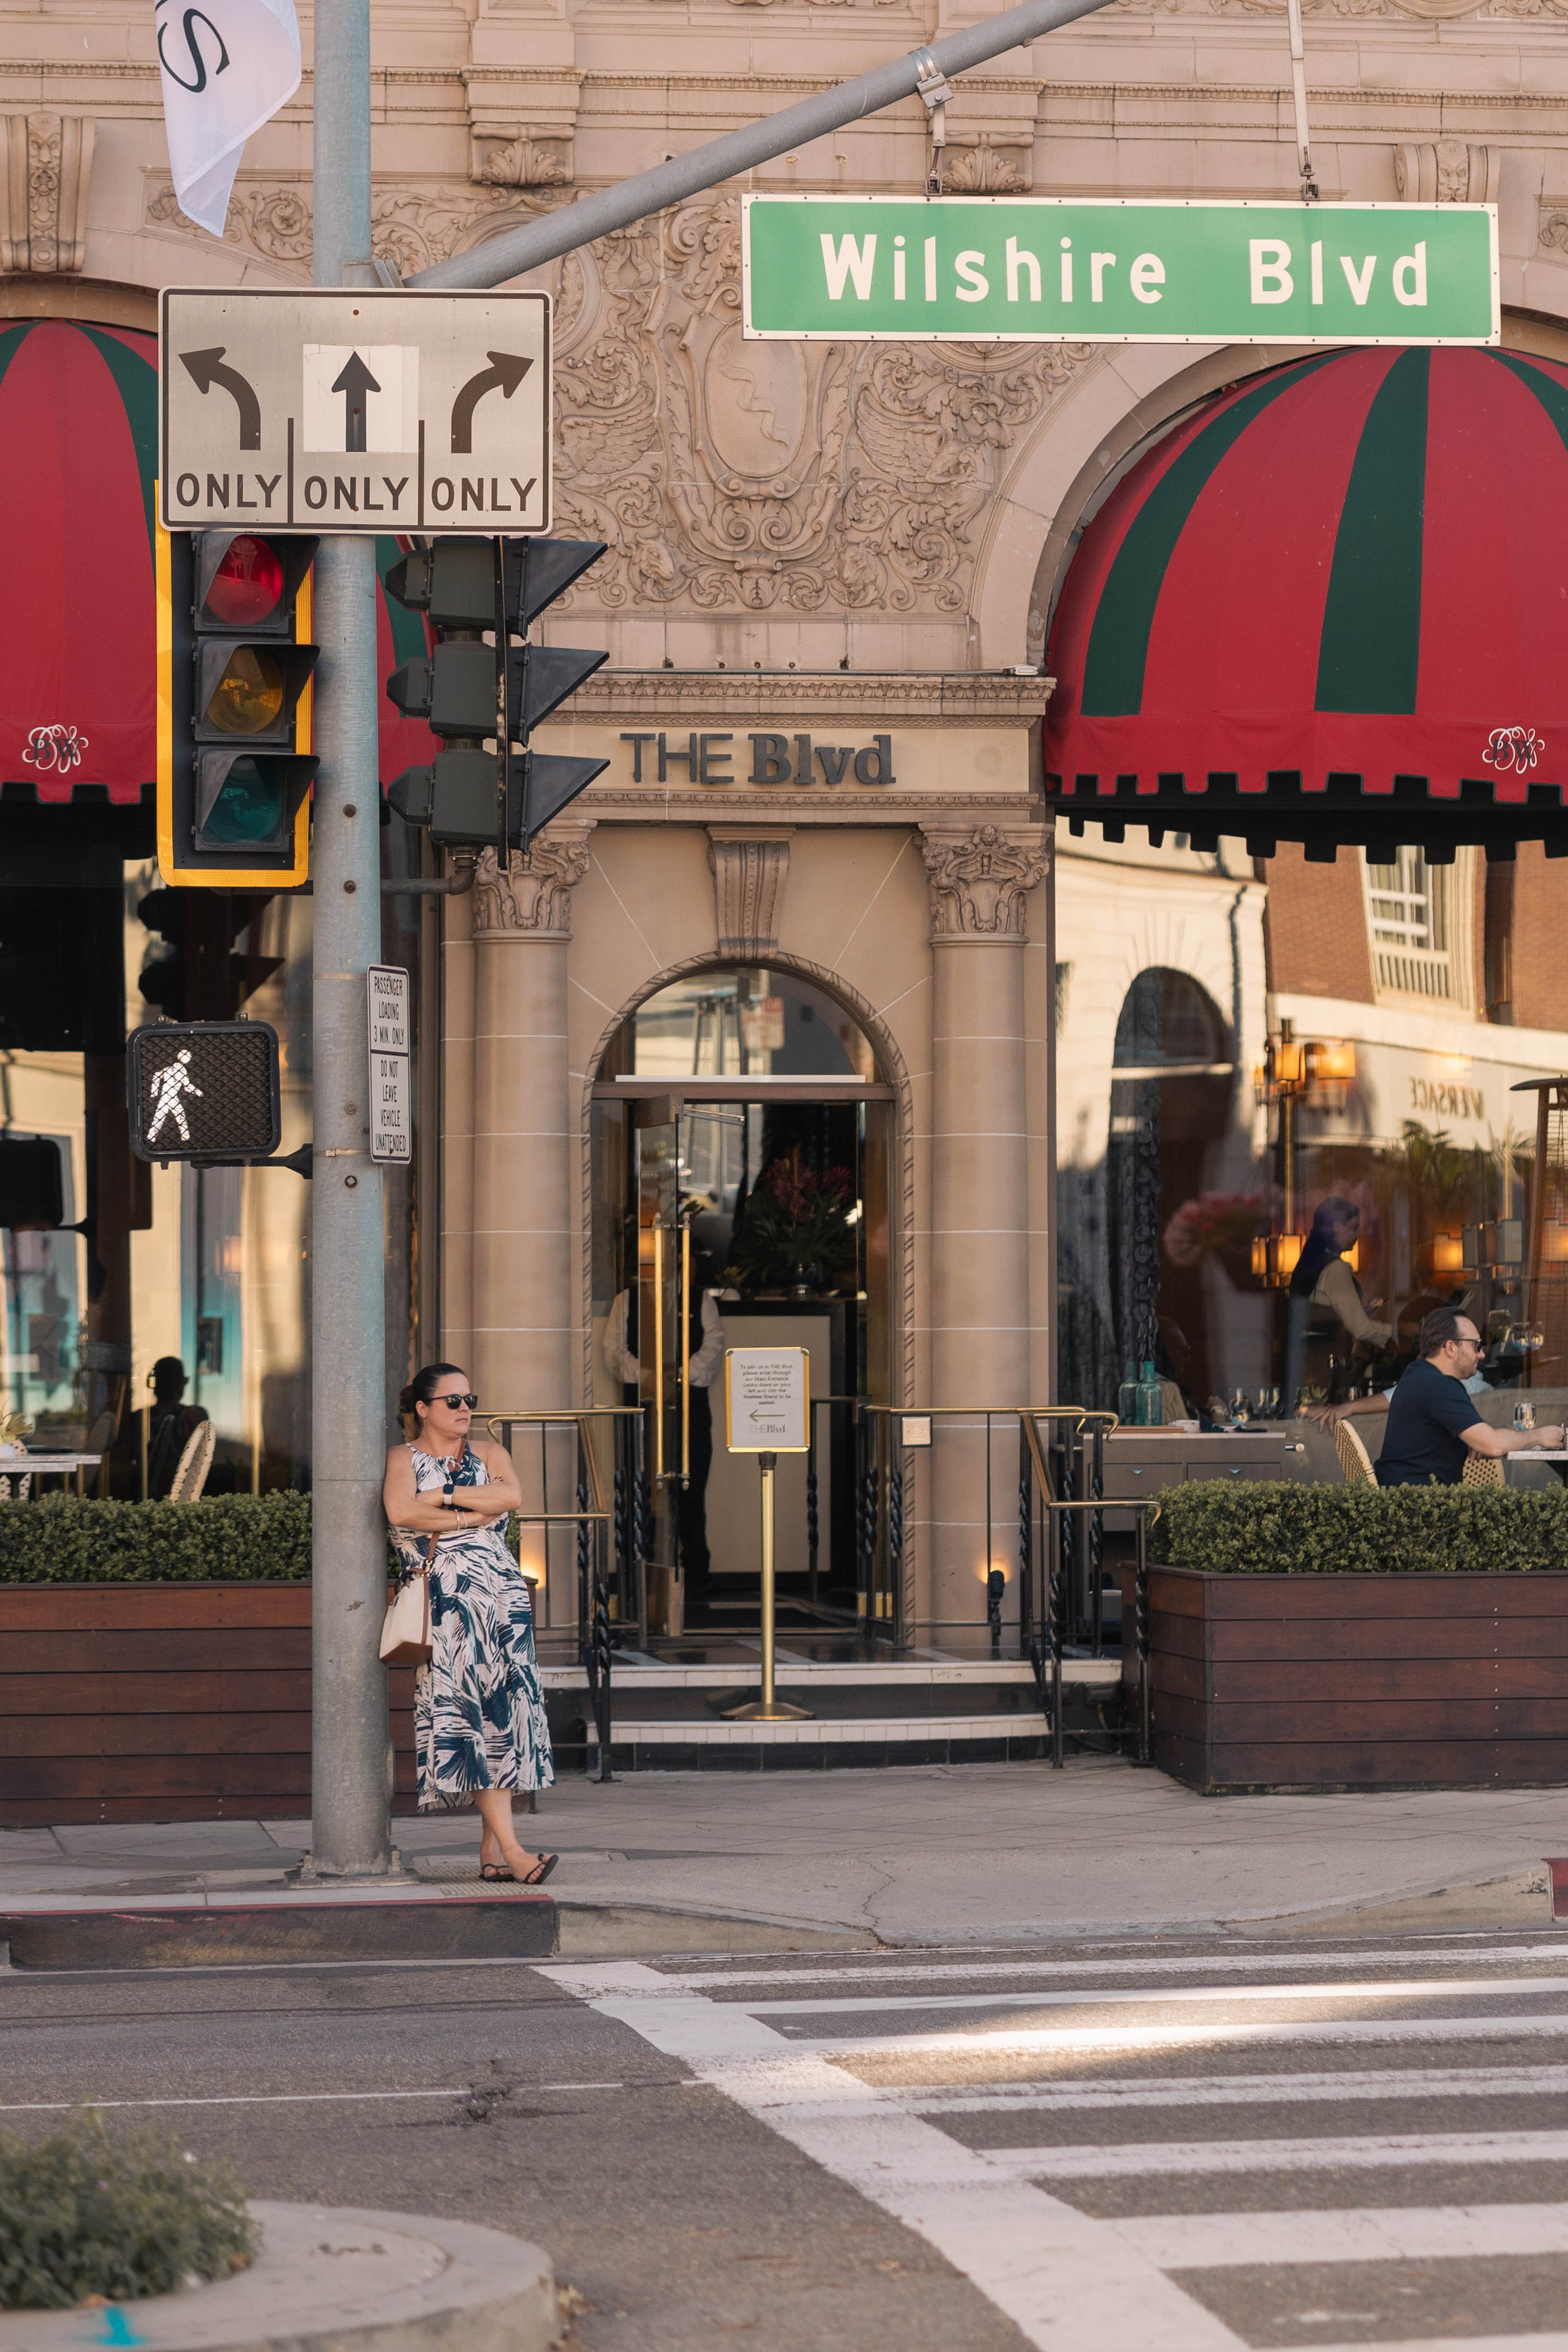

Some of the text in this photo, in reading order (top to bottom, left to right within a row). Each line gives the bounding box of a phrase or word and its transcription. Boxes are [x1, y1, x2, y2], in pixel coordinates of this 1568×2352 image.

[820, 233, 1428, 306] Wilshire Blvd
[176, 473, 282, 510] ONLY
[304, 476, 409, 512] ONLY
[431, 477, 538, 512] ONLY
[620, 732, 897, 785] THE Blvd
[374, 976, 403, 997] PASSENGER
[379, 1001, 399, 1021] LOADING
[374, 1025, 404, 1045] 3 MIN. ONLY
[380, 1060, 398, 1079] DO NOT
[382, 1084, 398, 1102] LEAVE
[380, 1109, 401, 1127] VEHICLE
[375, 1133, 406, 1152] UNATTENDED
